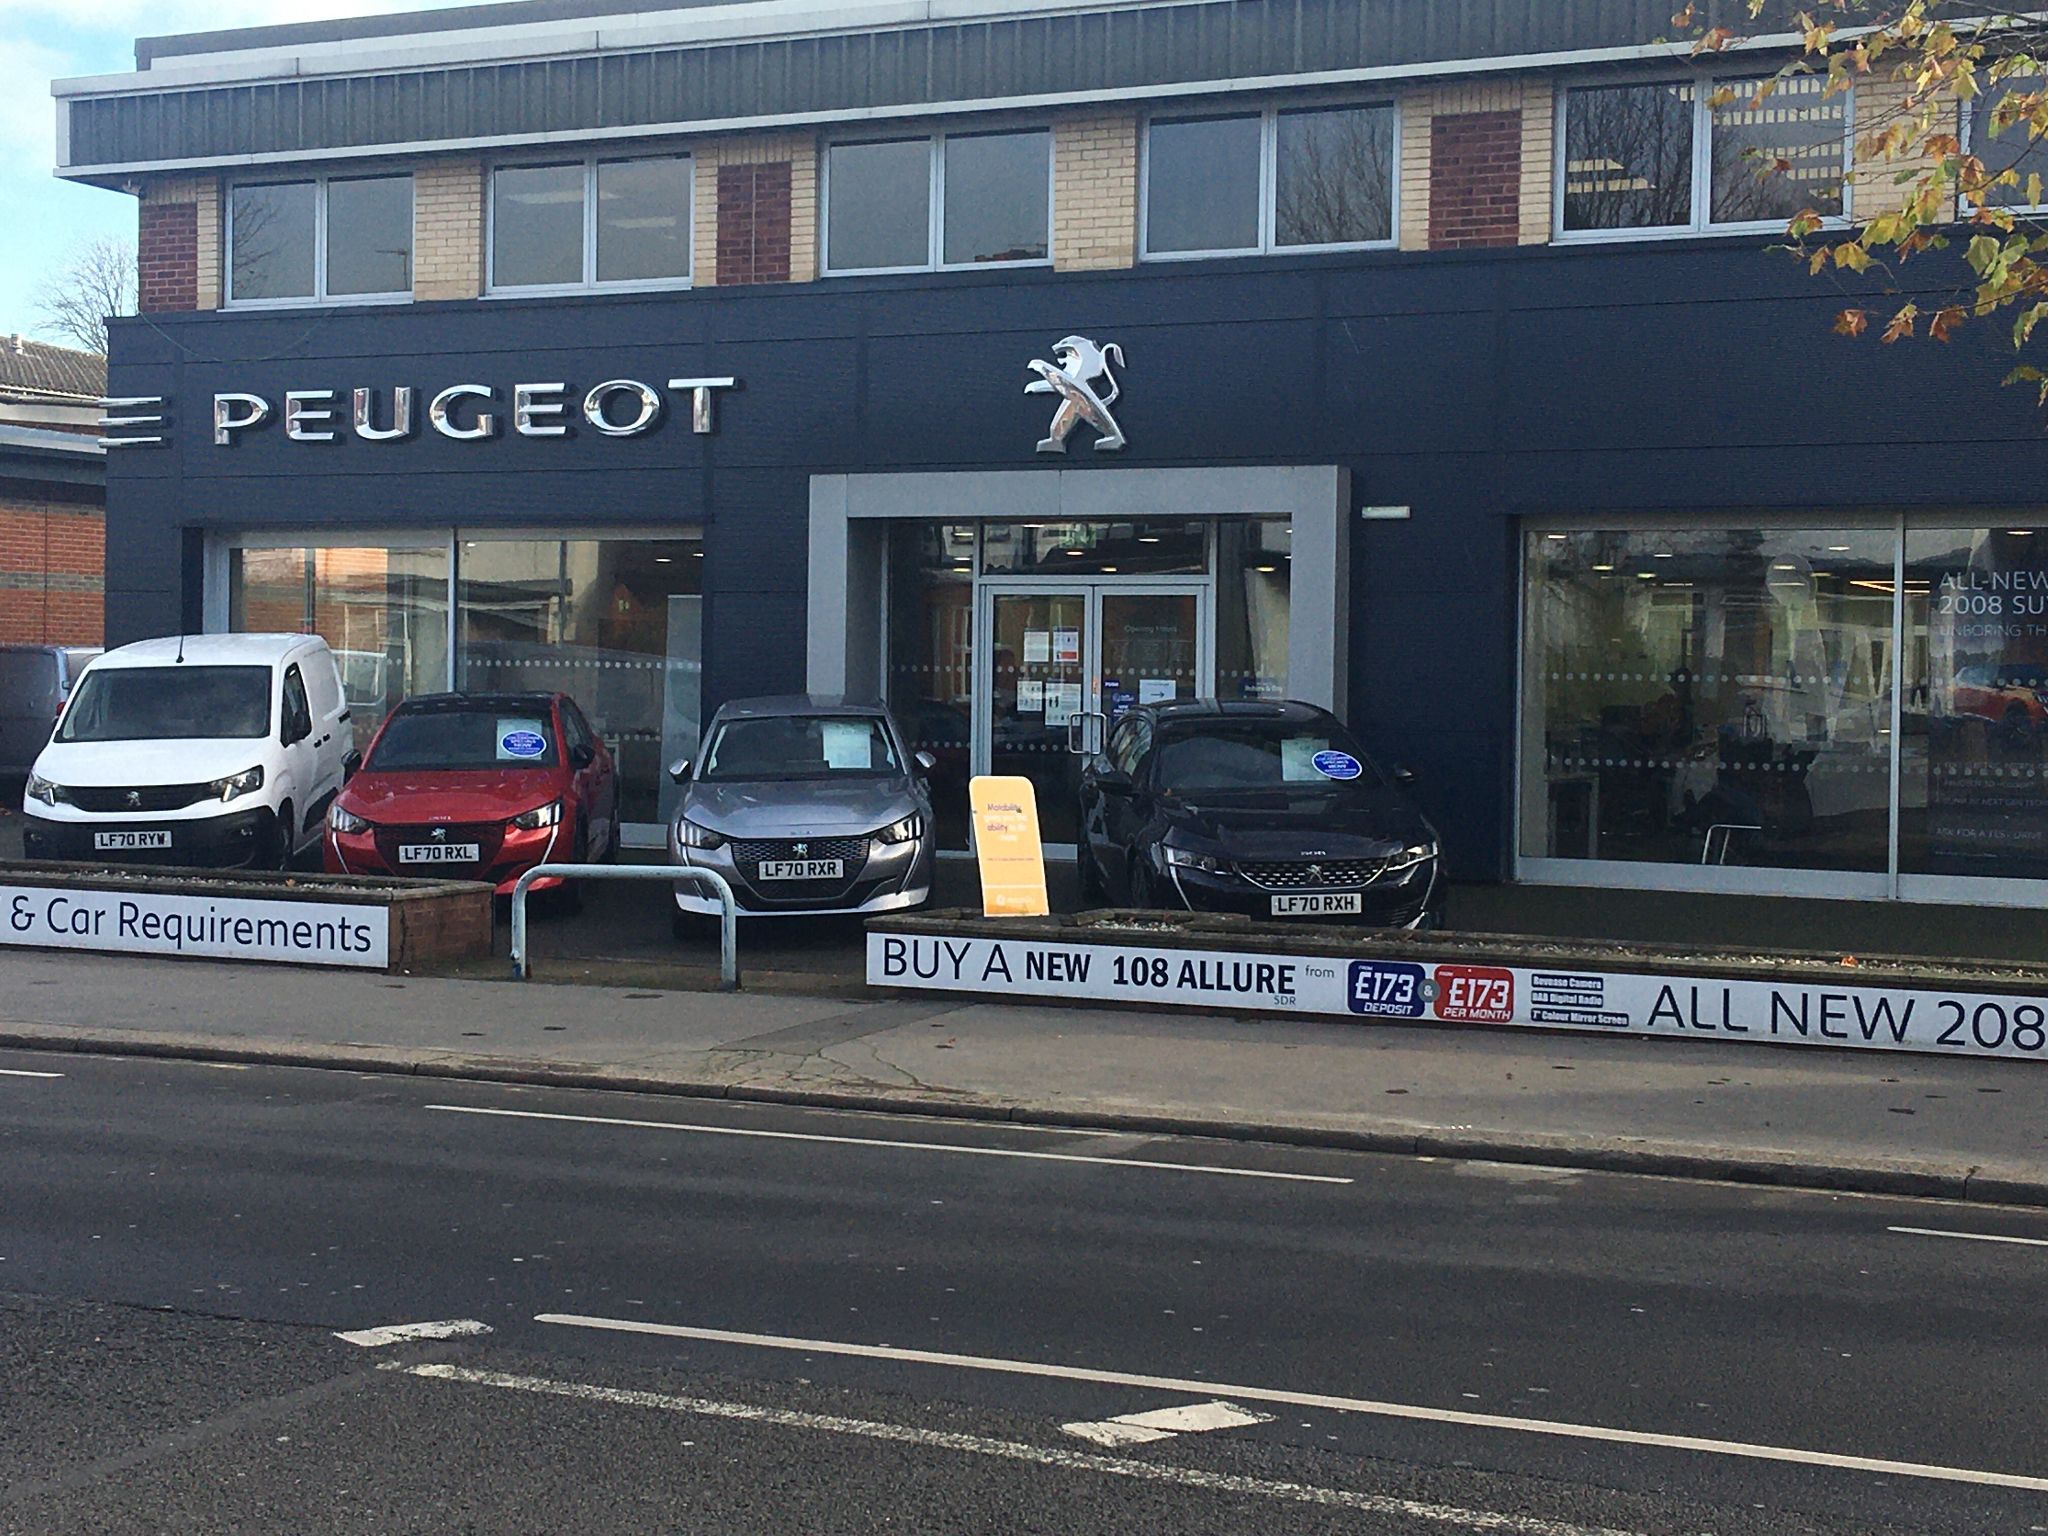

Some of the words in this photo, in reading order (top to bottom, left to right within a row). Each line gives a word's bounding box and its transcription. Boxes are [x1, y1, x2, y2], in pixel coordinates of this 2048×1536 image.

[214, 376, 735, 446] PEUGEOT
[1940, 571, 2048, 590] ALL-NEW
[1940, 595, 2003, 614] 2008
[2012, 595, 2048, 614] SU
[1941, 624, 2021, 637] UNBORING
[987, 823, 1008, 834] ability
[100, 834, 135, 847] LF70
[139, 833, 165, 846] RYW
[404, 847, 441, 860] LF70
[445, 846, 472, 859] RXL
[765, 863, 804, 876] LF70
[808, 862, 836, 875] RXR
[1277, 897, 1319, 912] LF70
[1323, 895, 1354, 911] RXH
[11, 896, 35, 931] &
[47, 897, 106, 935] Car
[119, 901, 371, 952] Requirements
[883, 938, 971, 980] BUY
[982, 944, 1013, 982] A
[1026, 951, 1091, 983] NEW
[1113, 956, 1169, 987] 108
[1177, 960, 1296, 995] ALLURE
[1305, 965, 1335, 978] from
[1355, 971, 1415, 1003] £173
[1569, 978, 1601, 989] Camera
[1423, 985, 1433, 997] &
[1449, 978, 1509, 1009] £173
[1274, 995, 1296, 1005] SDR
[1550, 993, 1577, 1004] Digital
[1579, 995, 1602, 1006] Radio
[1364, 1002, 1413, 1014] DEPOSIT
[1443, 1007, 1467, 1017] PER
[1469, 1008, 1511, 1020] MONTH
[1541, 1010, 1569, 1021] Colour
[1570, 1012, 1597, 1023] Mirror
[1598, 1014, 1628, 1026] Screen
[1647, 985, 1748, 1032] ALL
[1771, 991, 1915, 1042] NEW
[1936, 1000, 2046, 1051] 208
